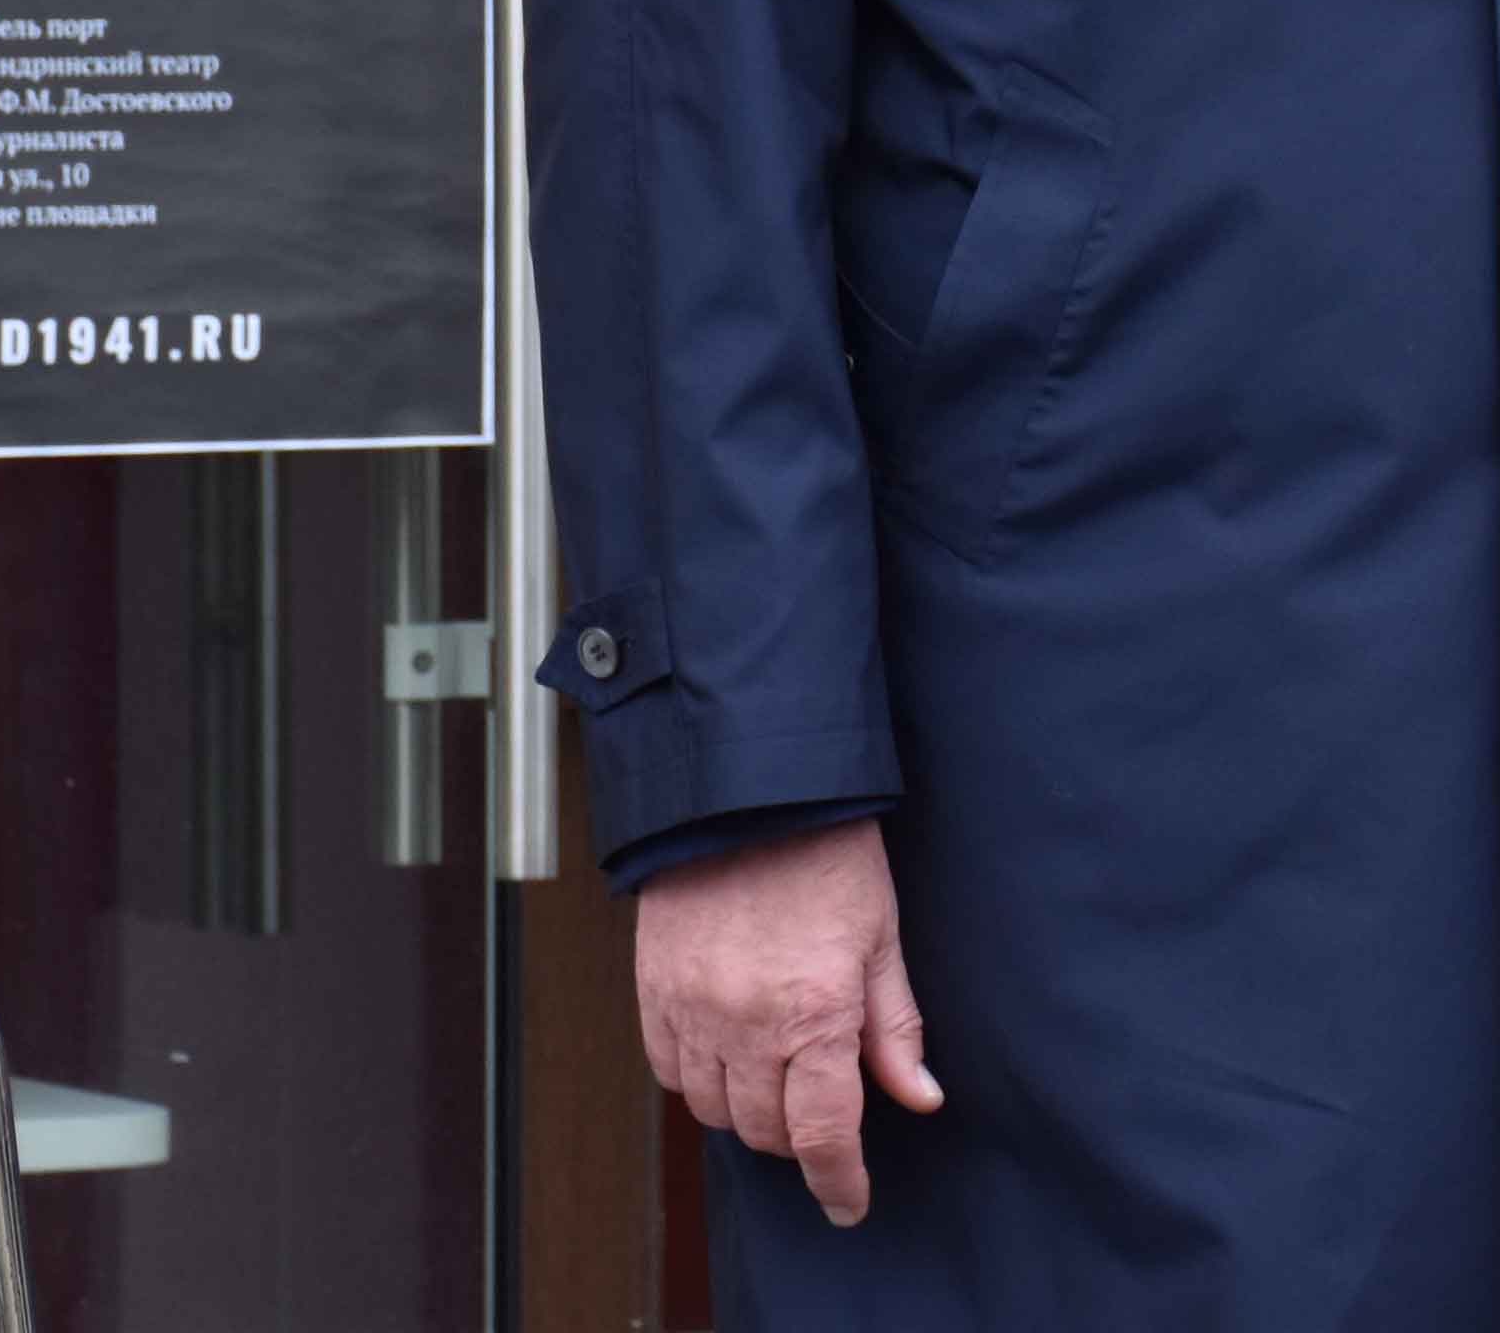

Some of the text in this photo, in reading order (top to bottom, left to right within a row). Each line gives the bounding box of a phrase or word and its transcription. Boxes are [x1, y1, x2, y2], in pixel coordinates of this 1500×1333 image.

[46, 18, 108, 45] порт
[148, 54, 220, 81] театр
[61, 87, 234, 115] Достоевского
[8, 167, 55, 195] ул.,
[60, 161, 91, 189] 10
[25, 204, 158, 227] площадки
